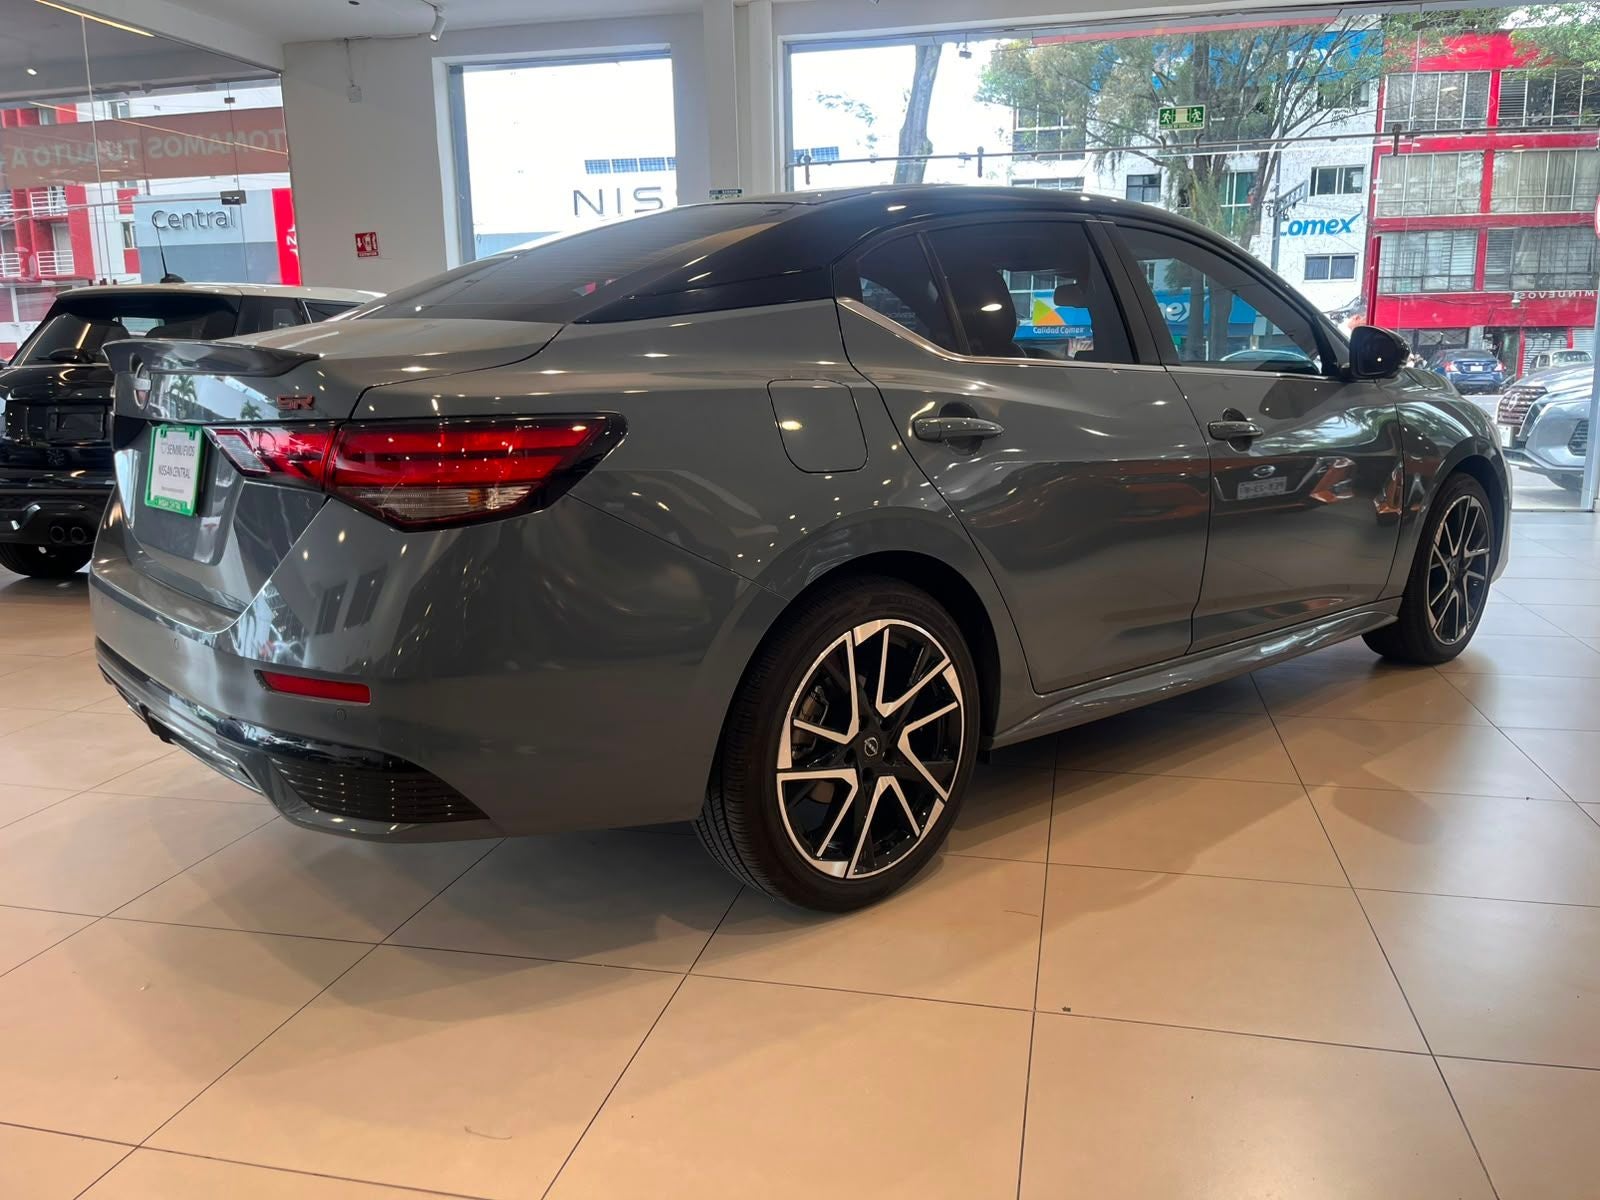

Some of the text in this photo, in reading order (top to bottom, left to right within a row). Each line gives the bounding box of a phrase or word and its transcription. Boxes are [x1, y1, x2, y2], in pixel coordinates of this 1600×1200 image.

[573, 186, 663, 216] NIS
[151, 206, 235, 230] Central
[1280, 211, 1362, 237] omex
[1033, 326, 1084, 335] Calidad Comex
[276, 393, 314, 410] SR
